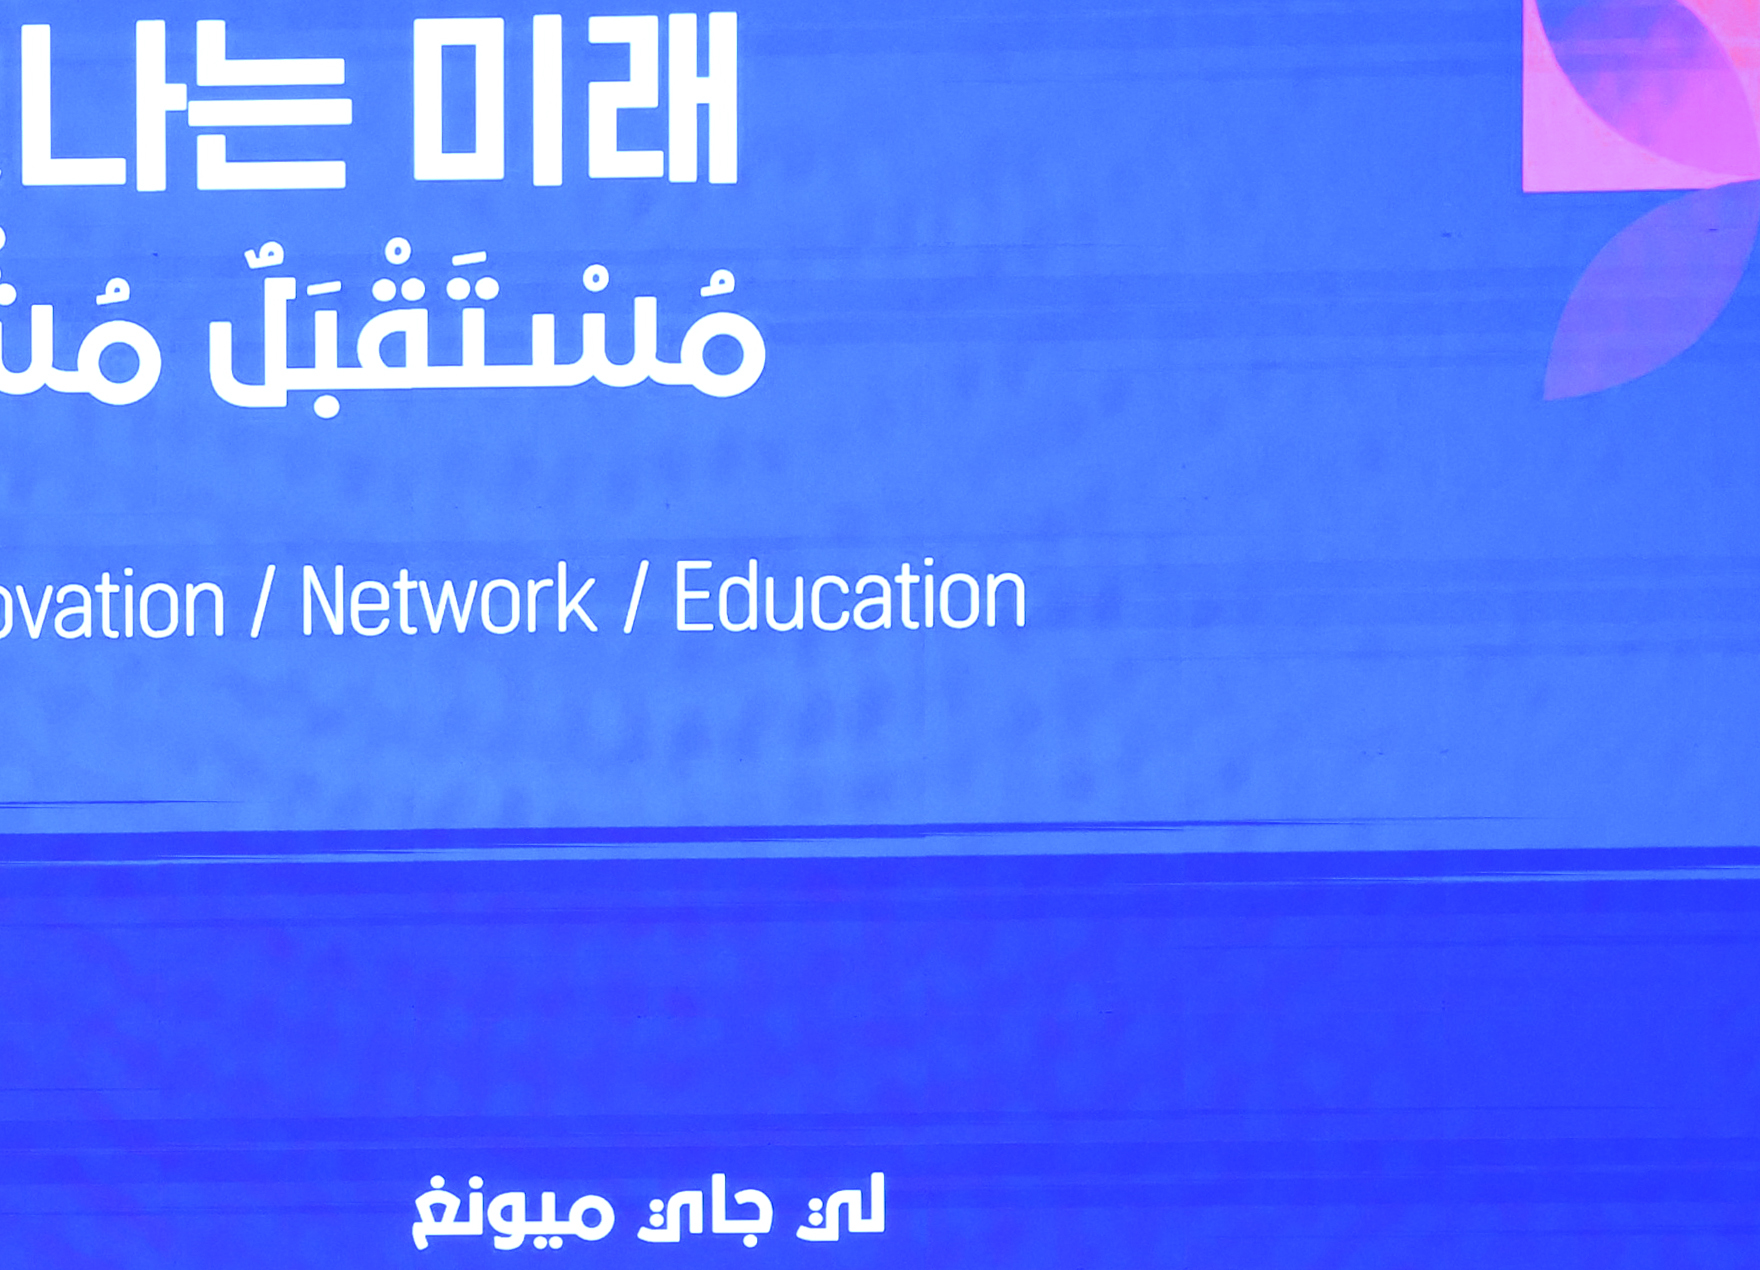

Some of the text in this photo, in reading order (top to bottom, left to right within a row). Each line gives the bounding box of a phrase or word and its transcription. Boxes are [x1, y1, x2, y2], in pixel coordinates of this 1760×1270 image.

[413, 11, 738, 187] 미래
[302, 560, 598, 637] Network
[675, 556, 1026, 632] Education
[412, 1171, 886, 1251] لي جاي ميونغ
